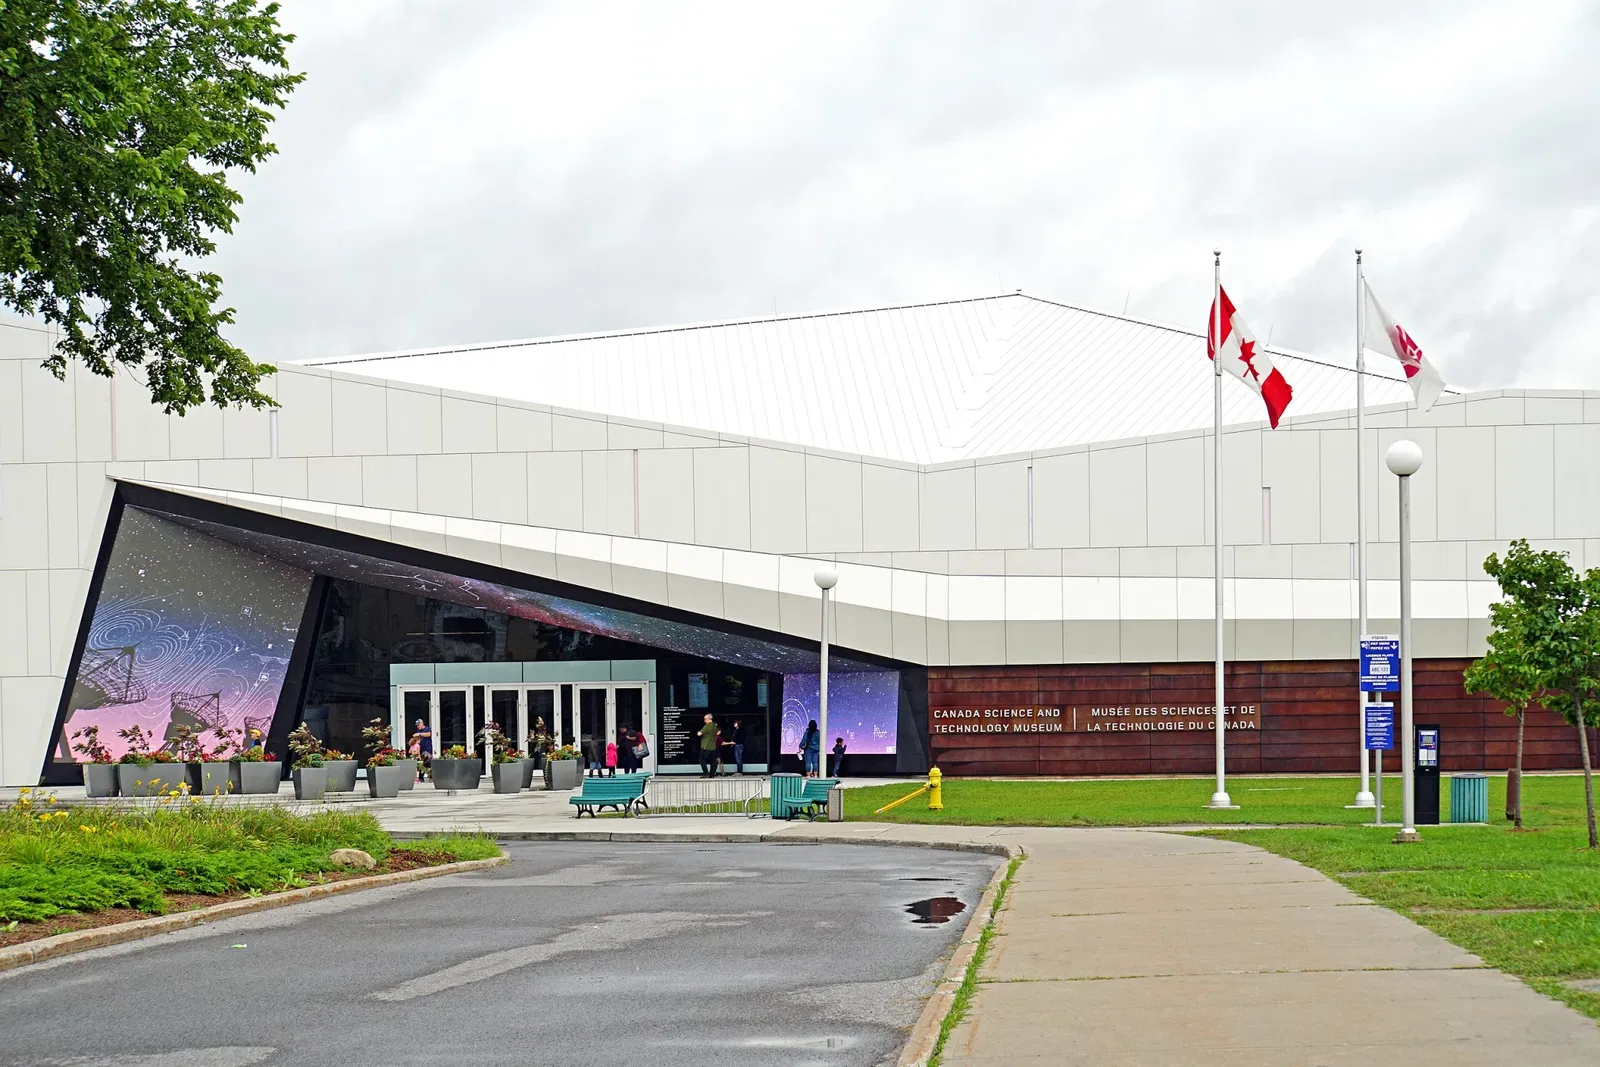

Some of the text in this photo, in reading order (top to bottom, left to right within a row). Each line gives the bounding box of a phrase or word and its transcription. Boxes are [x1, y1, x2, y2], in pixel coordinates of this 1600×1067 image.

[934, 708, 1060, 718] CANADA SCIENCE AND
[1092, 706, 1130, 716] MUSÉE
[1135, 708, 1157, 716] DES
[1241, 706, 1256, 714] DE
[934, 724, 1062, 732] TECHNOLOGY MUSEUM
[1087, 720, 1255, 731] LA TECHNOLOGIE DU CNADA
